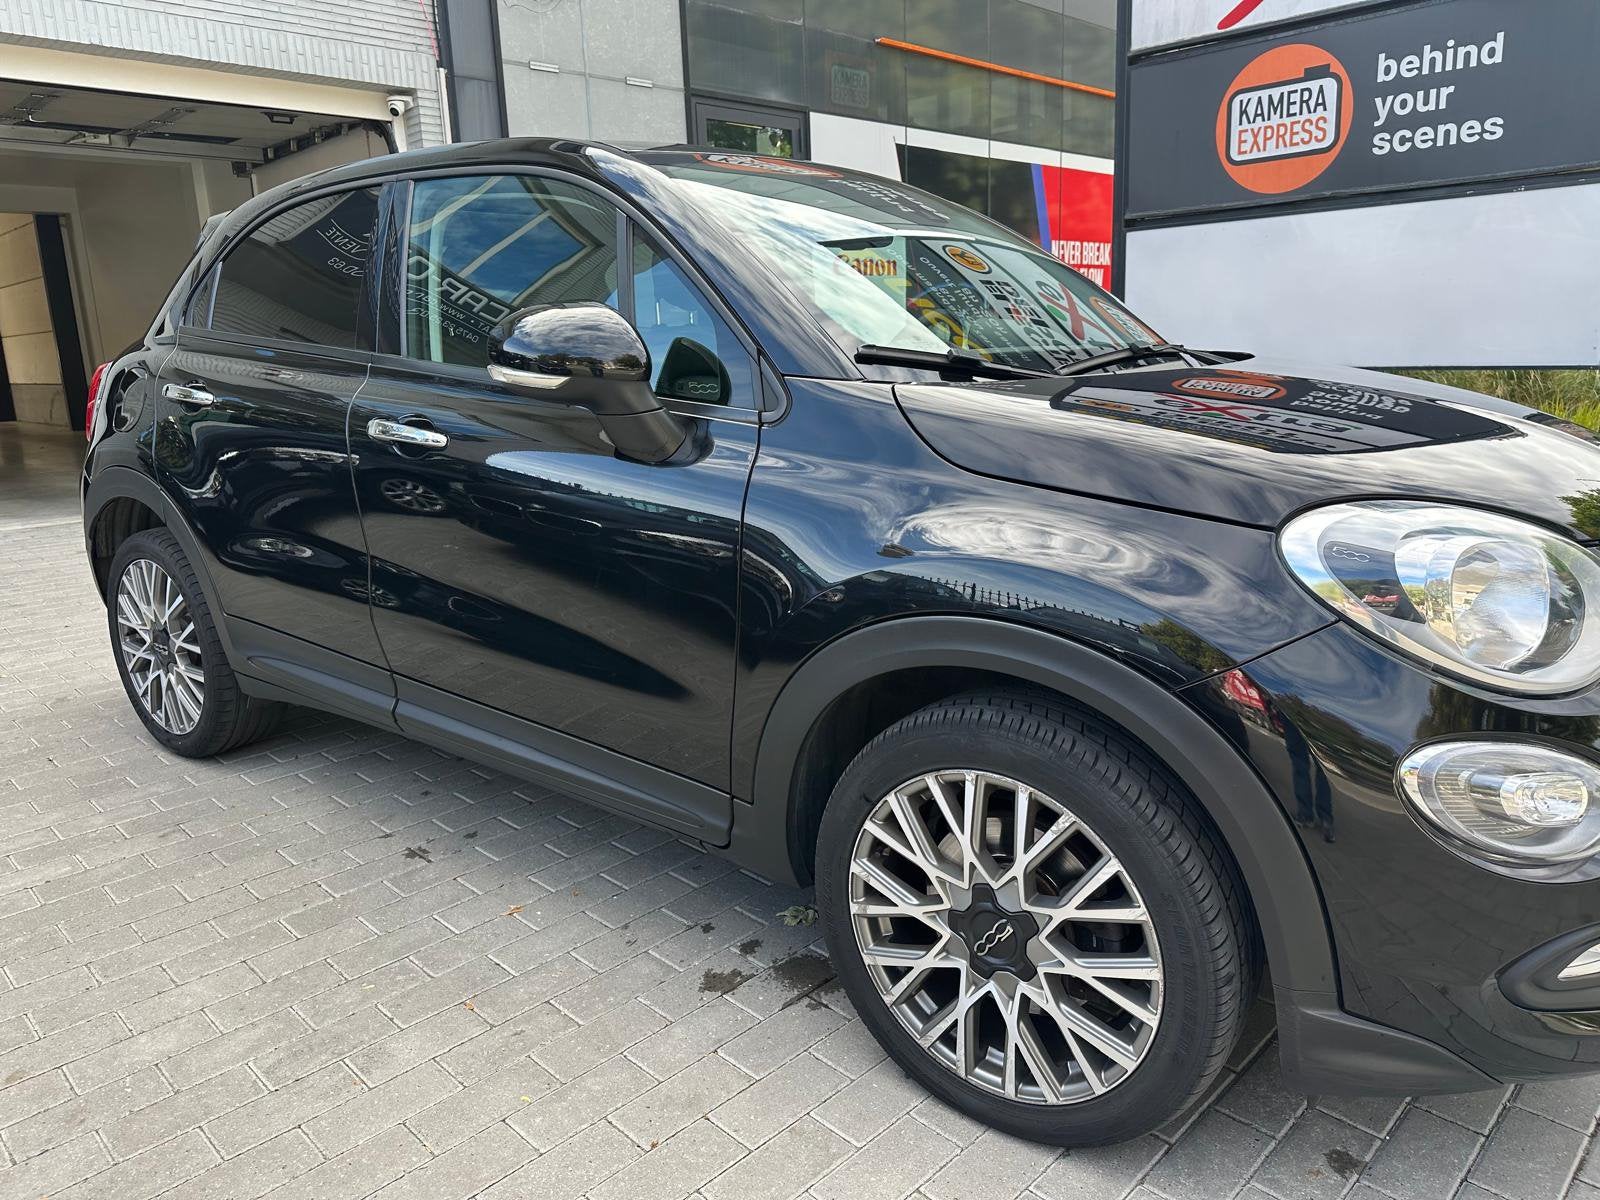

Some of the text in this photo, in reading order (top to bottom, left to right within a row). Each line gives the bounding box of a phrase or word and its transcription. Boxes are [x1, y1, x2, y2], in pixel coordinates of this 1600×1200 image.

[1376, 31, 1505, 83] behind
[1238, 84, 1328, 126] KAMERA
[1373, 85, 1456, 127] your
[1237, 115, 1328, 156] EXPRESS
[1371, 116, 1504, 156] scenes
[1051, 239, 1112, 266] NEVER BREAK
[1331, 546, 1370, 563] 500
[973, 918, 1014, 957] 500
